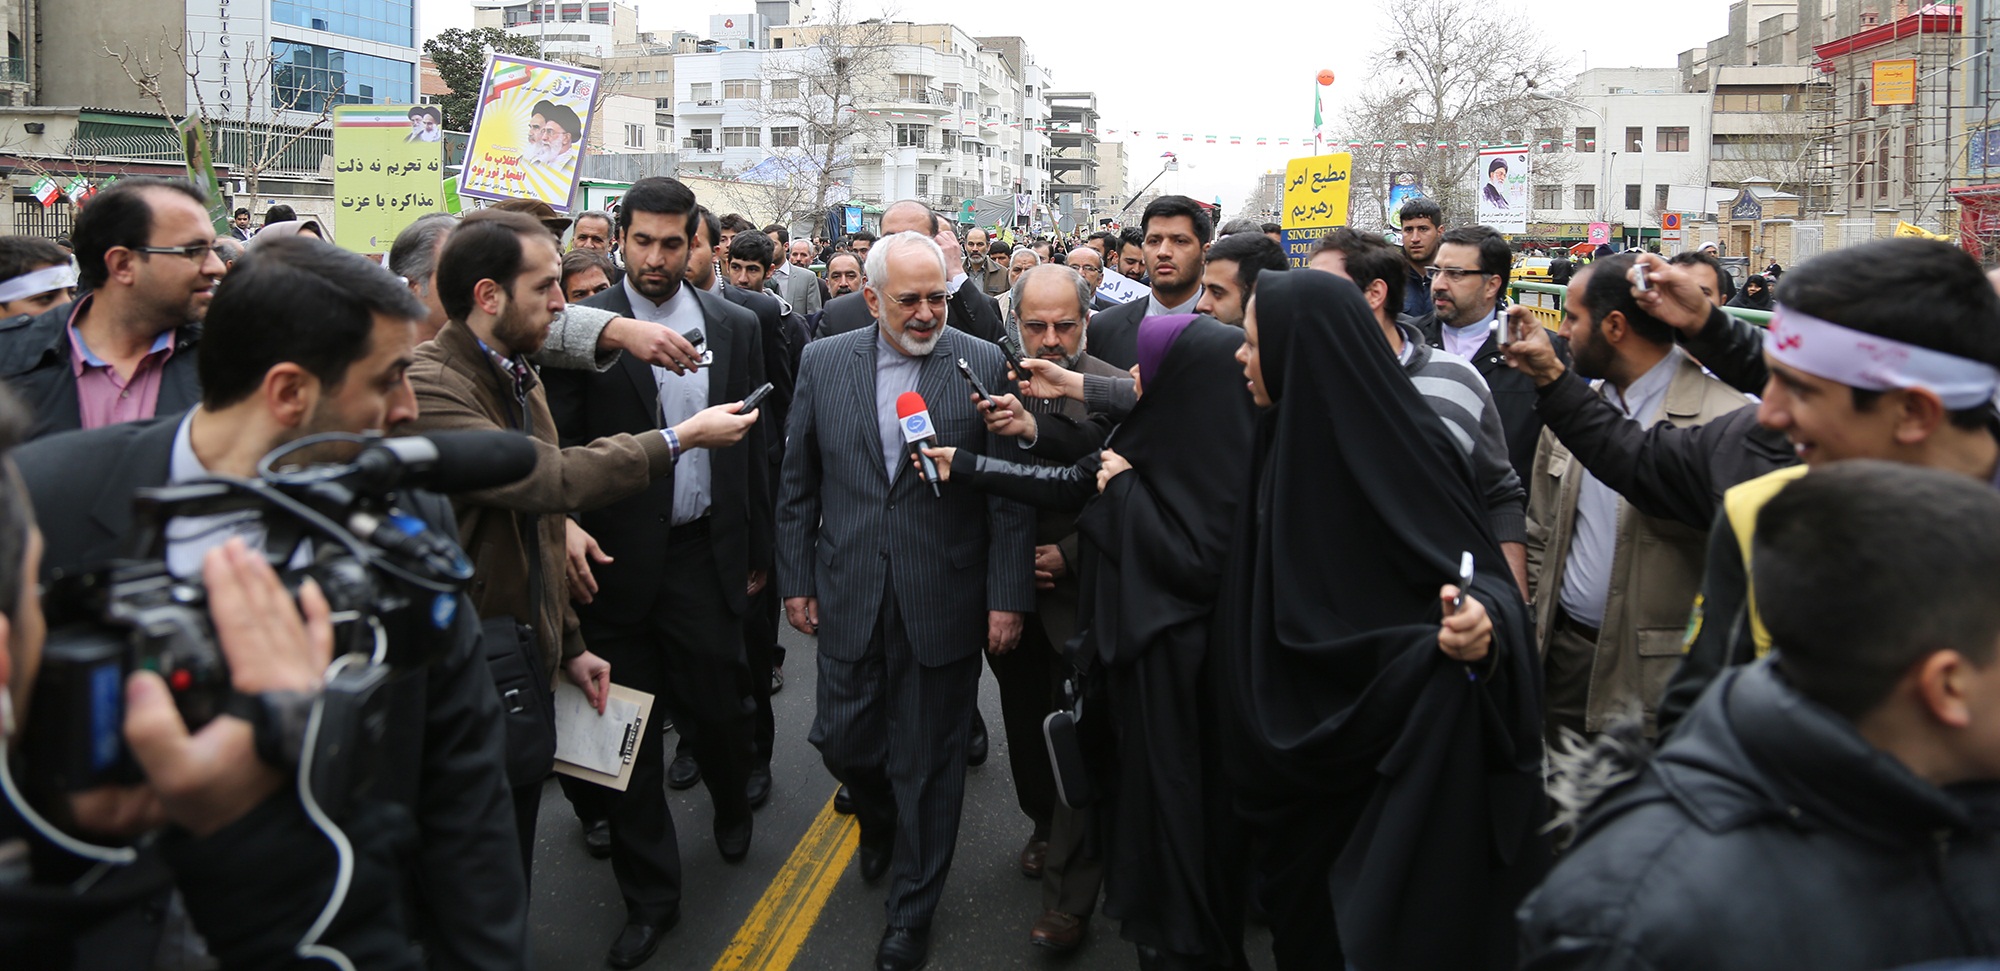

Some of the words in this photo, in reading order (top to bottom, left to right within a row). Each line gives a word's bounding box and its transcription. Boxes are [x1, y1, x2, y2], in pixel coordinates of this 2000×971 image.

[485, 152, 493, 162] ما
[494, 155, 520, 166] انقلاب
[336, 158, 363, 172] ذلت
[369, 158, 381, 172] نه
[387, 158, 421, 176] تحریم
[427, 158, 439, 172] نه
[472, 165, 485, 176] بود
[485, 168, 500, 178] نور
[500, 169, 526, 181] انفجار
[1288, 167, 1308, 191] امر
[1311, 163, 1346, 193] مطیع
[341, 196, 370, 211] عزت
[376, 194, 385, 210] با
[391, 193, 434, 211] مذاکره
[1291, 200, 1333, 226] رهبریم
[1098, 281, 1121, 292] امر
